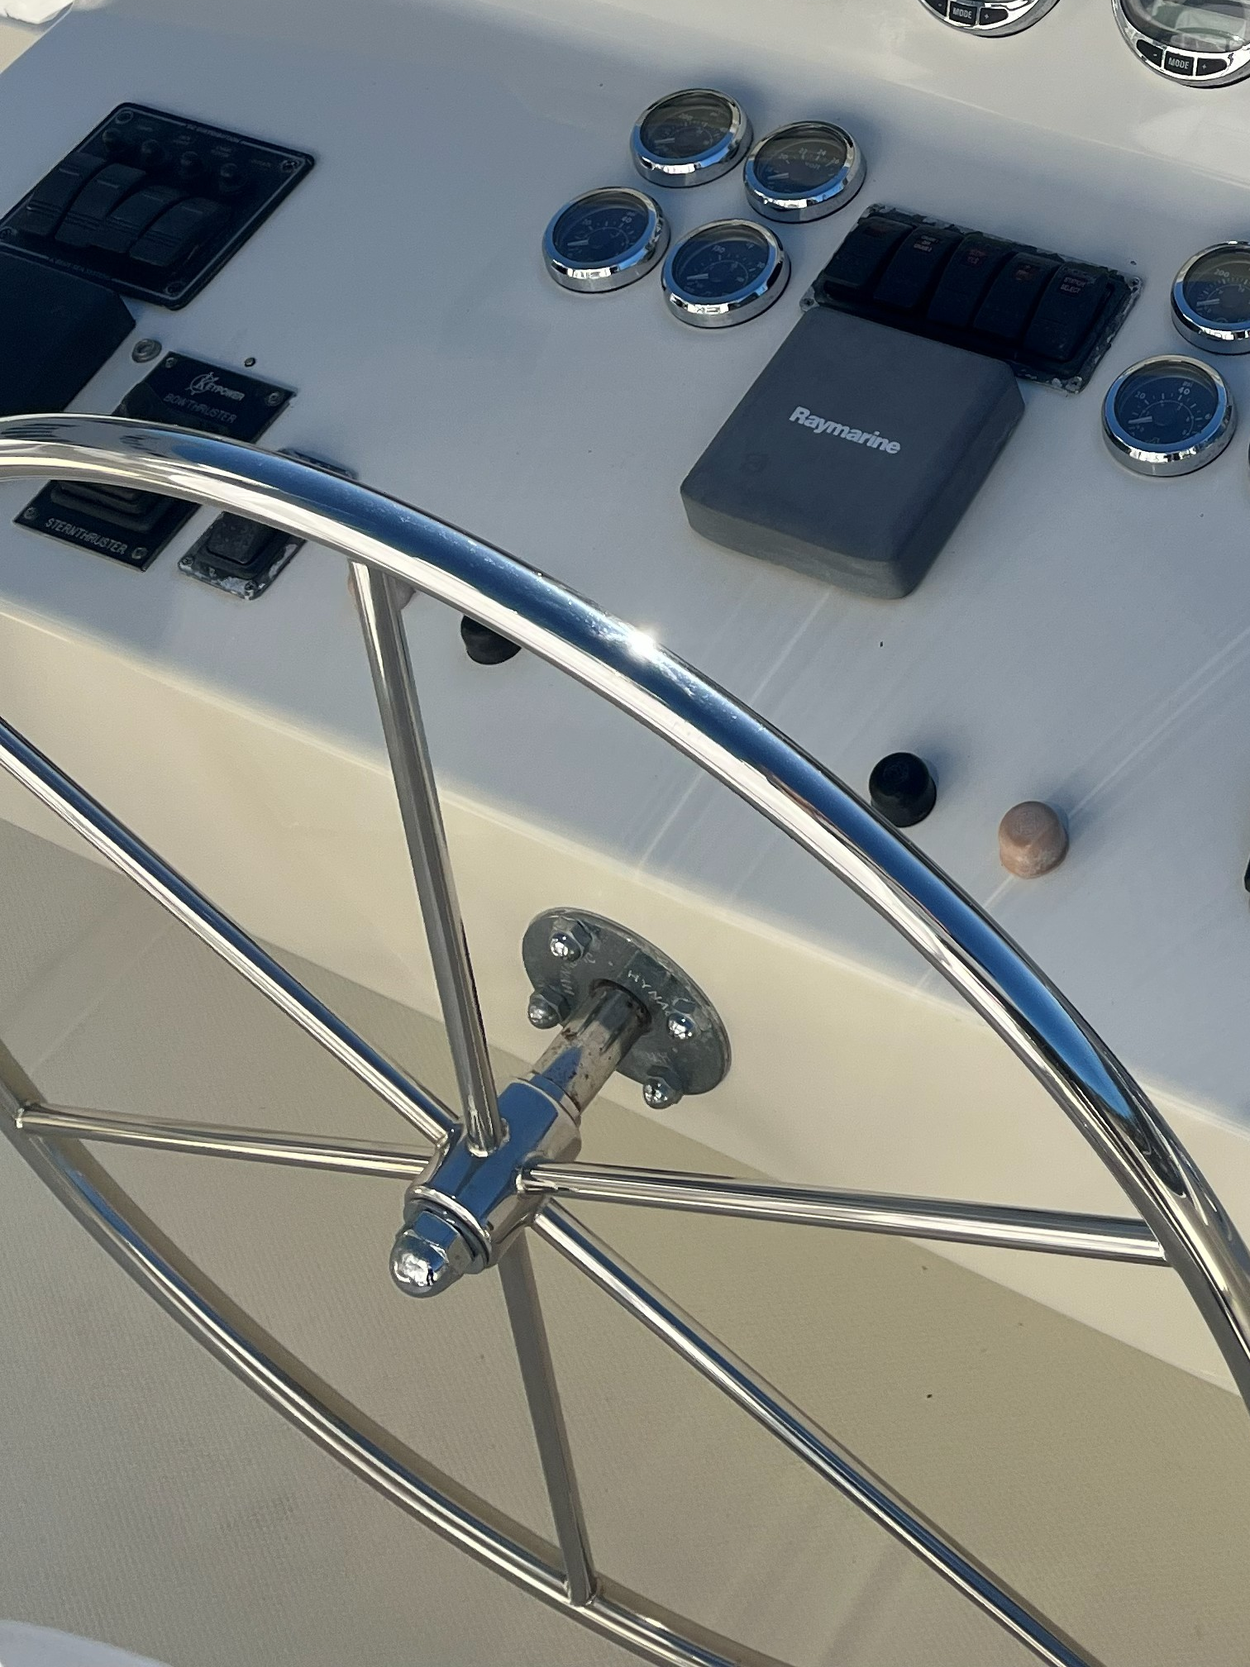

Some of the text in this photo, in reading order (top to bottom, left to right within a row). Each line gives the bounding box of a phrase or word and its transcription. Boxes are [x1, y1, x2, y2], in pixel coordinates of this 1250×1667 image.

[952, 7, 972, 19] MODE
[1168, 57, 1189, 69] MODE
[1214, 268, 1229, 277] 200
[1178, 386, 1190, 395] 40
[163, 393, 237, 423] BOWTHRUSTER
[789, 406, 901, 454] Raymarine
[46, 518, 128, 554] STERNTHRUSTER
